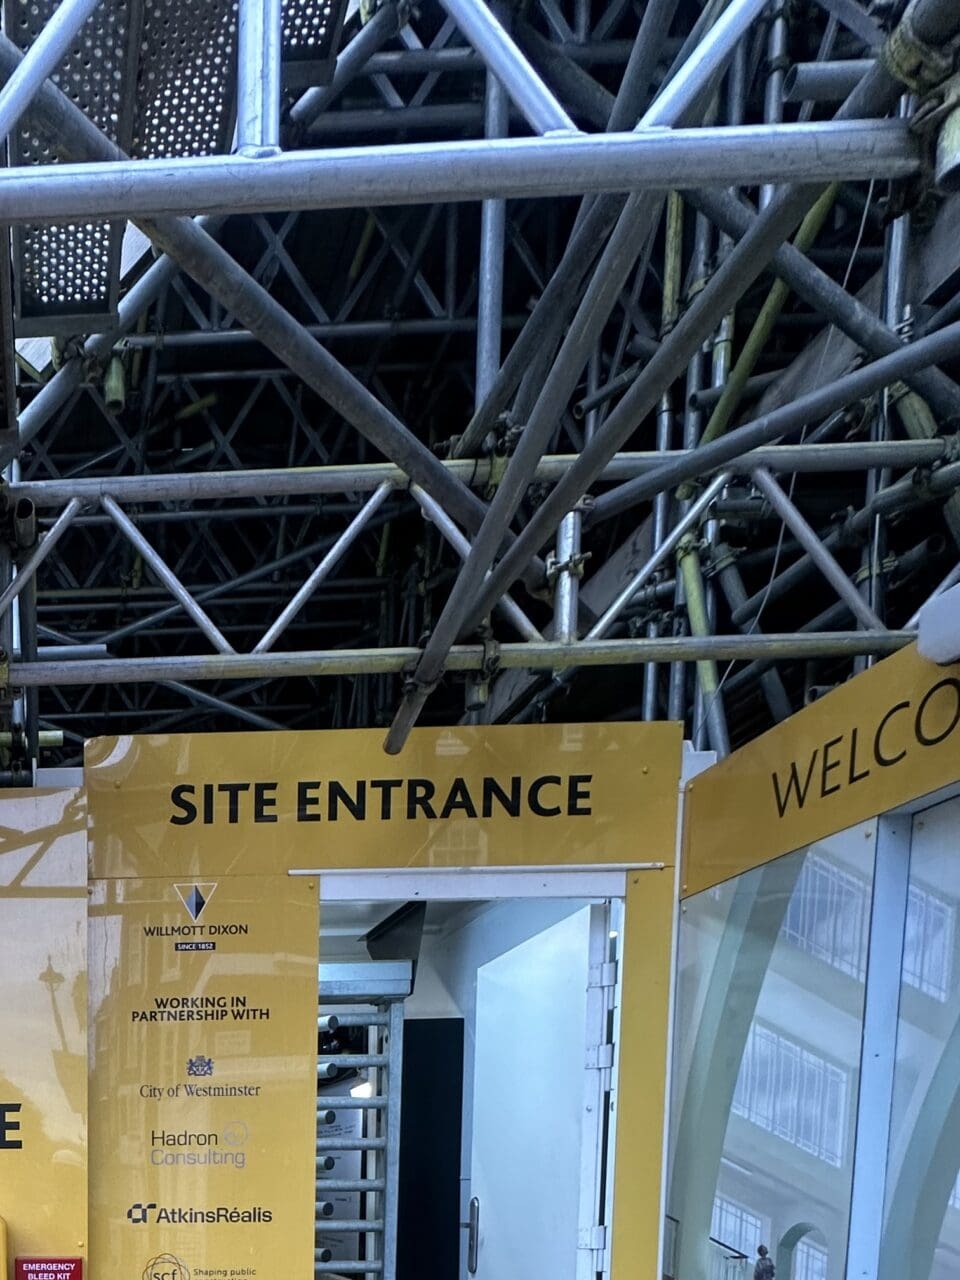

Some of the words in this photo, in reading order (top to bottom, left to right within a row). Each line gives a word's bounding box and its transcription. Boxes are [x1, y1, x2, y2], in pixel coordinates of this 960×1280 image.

[772, 677, 960, 818] WELCO
[170, 782, 278, 825] SITE
[297, 774, 593, 821] ENTRANCE
[143, 926, 205, 936] WILLMOTT
[208, 924, 248, 935] DIXON
[154, 997, 226, 1009] WORKING
[231, 996, 246, 1008] IN
[131, 1010, 228, 1022] PARTNERSHIP
[231, 1008, 269, 1020] WITH
[139, 1083, 164, 1100] City
[167, 1083, 180, 1097] of
[184, 1084, 261, 1098] Westminster
[151, 1130, 218, 1146] Hadron
[151, 1149, 246, 1168] Consulting
[156, 1207, 272, 1223] AtkinsRéalis
[193, 1268, 227, 1277] Shaping
[230, 1268, 256, 1277] public
